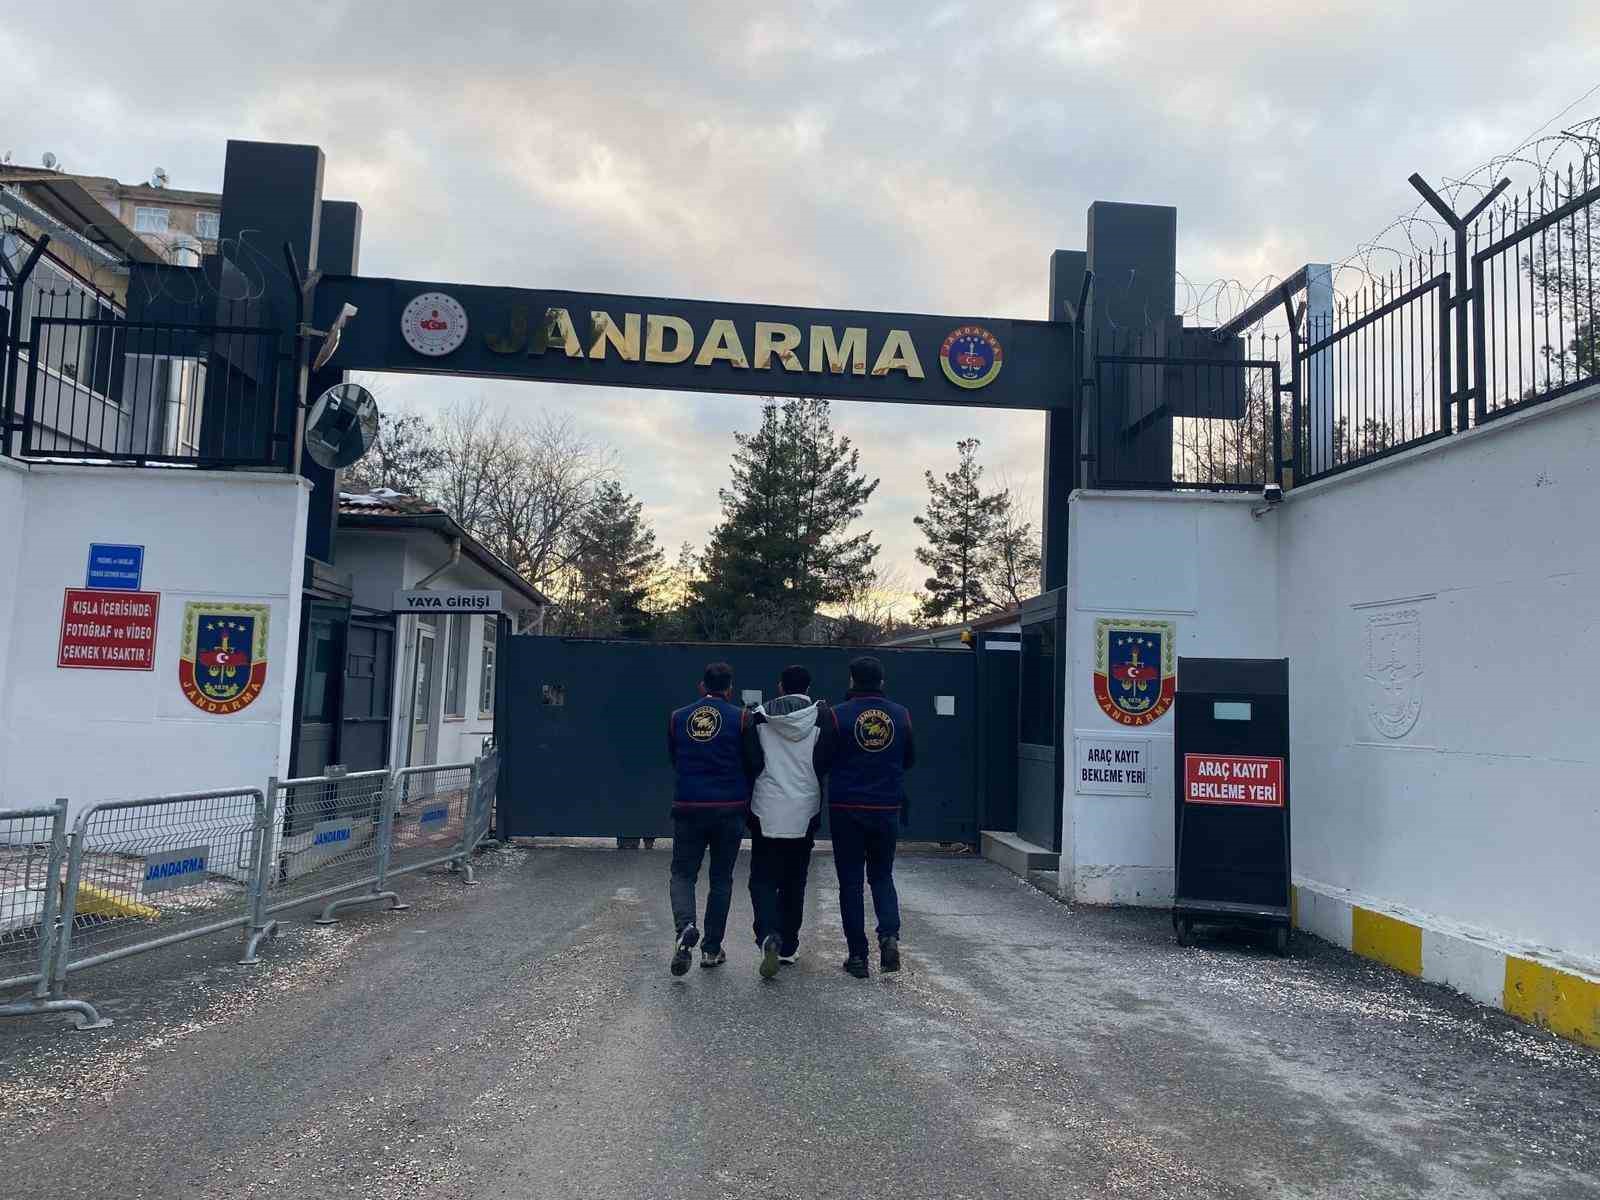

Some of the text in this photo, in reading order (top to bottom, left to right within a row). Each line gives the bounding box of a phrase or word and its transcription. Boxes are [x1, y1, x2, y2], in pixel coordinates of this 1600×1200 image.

[486, 304, 926, 380] JANDARMA
[72, 598, 150, 618] KIŞLA İÇERİSİNDE
[407, 595, 490, 608] YAYA GİRİŞİ
[66, 621, 152, 640] FOTOĞRAF ve VİDEO
[63, 644, 99, 662] ÇEKMEK
[101, 645, 145, 662] YASAKTIR
[183, 681, 262, 713] JANDARMA
[1098, 695, 1172, 725] JANDARMA
[1088, 749, 1140, 766] ARAÇ KAYIT
[1081, 768, 1146, 784] BEKLEME YERİ
[1198, 762, 1268, 780] ARAÇ KAYIT
[1190, 782, 1277, 801] BEKLEME YERİ
[314, 827, 352, 846] JANDARMA
[145, 856, 205, 881] JANDARMA
